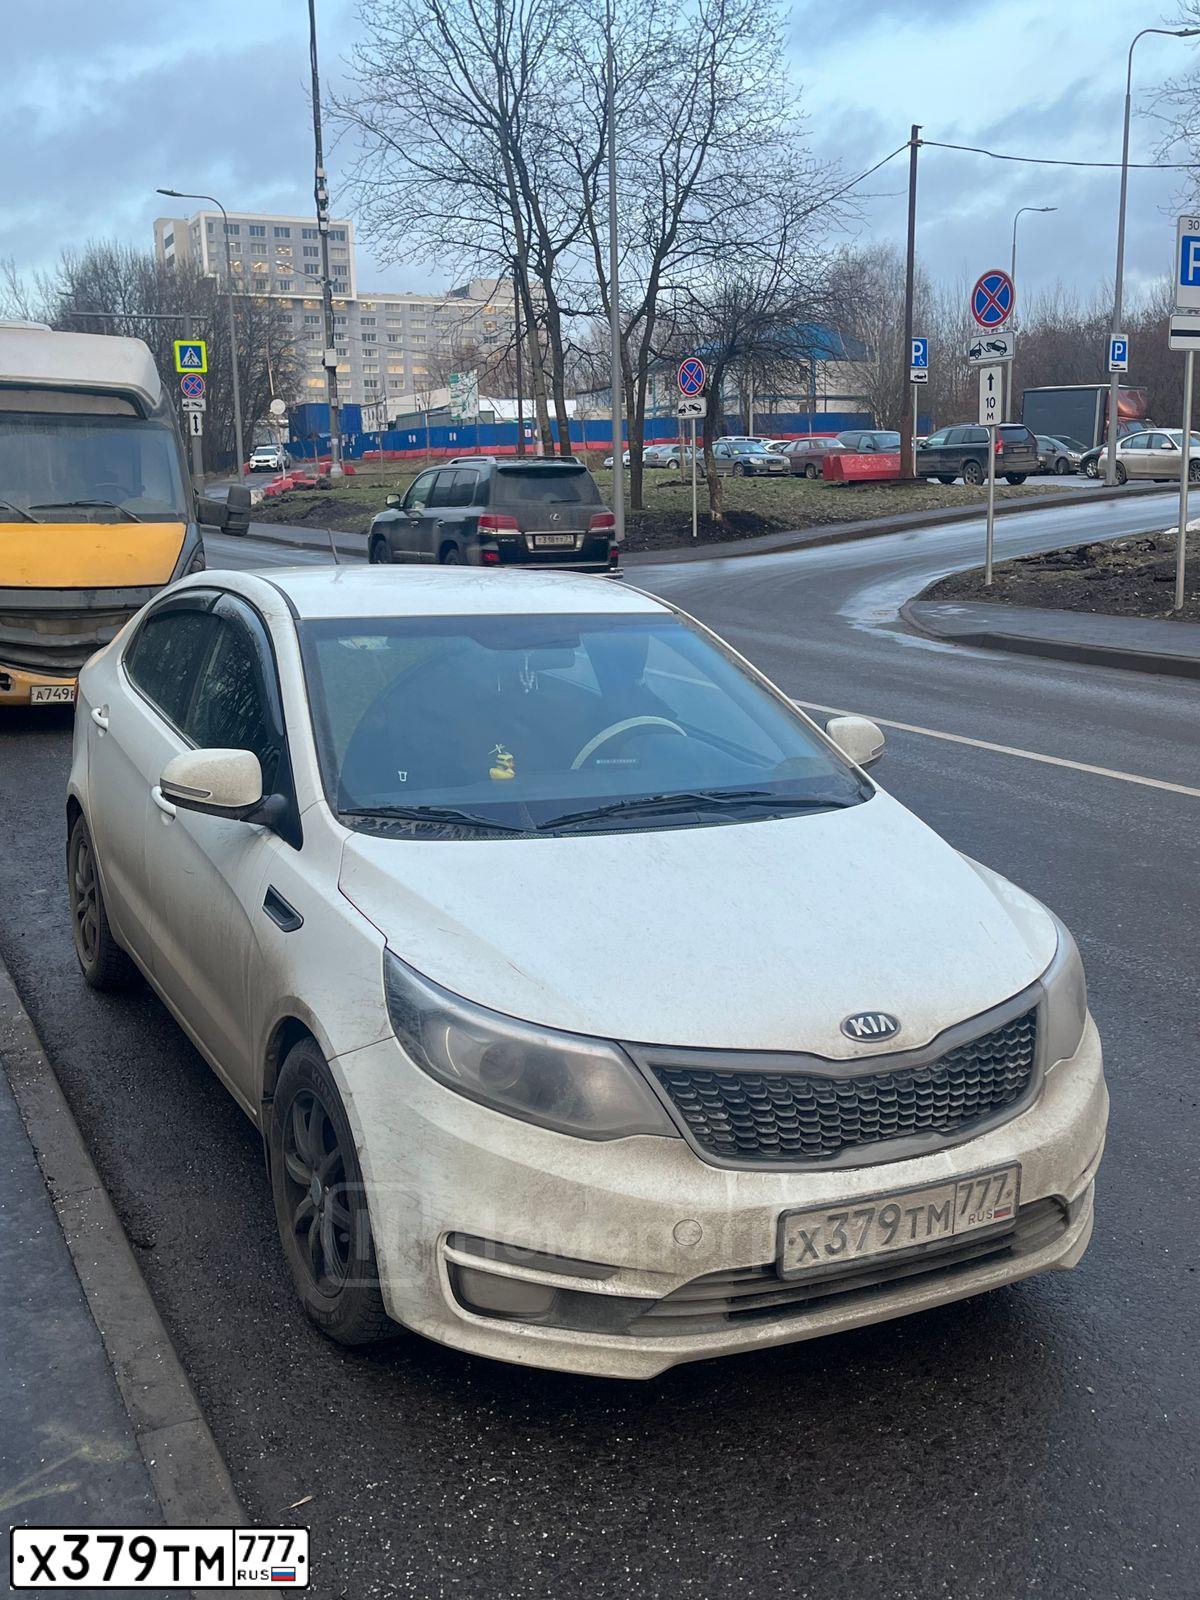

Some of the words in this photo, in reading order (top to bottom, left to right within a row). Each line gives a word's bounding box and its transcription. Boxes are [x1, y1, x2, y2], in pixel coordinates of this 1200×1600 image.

[911, 341, 924, 364] P
[1114, 342, 1124, 360] P
[985, 397, 996, 409] 10
[849, 1014, 896, 1036] KIA
[958, 1172, 1009, 1216] 777
[968, 1212, 993, 1225] RUS
